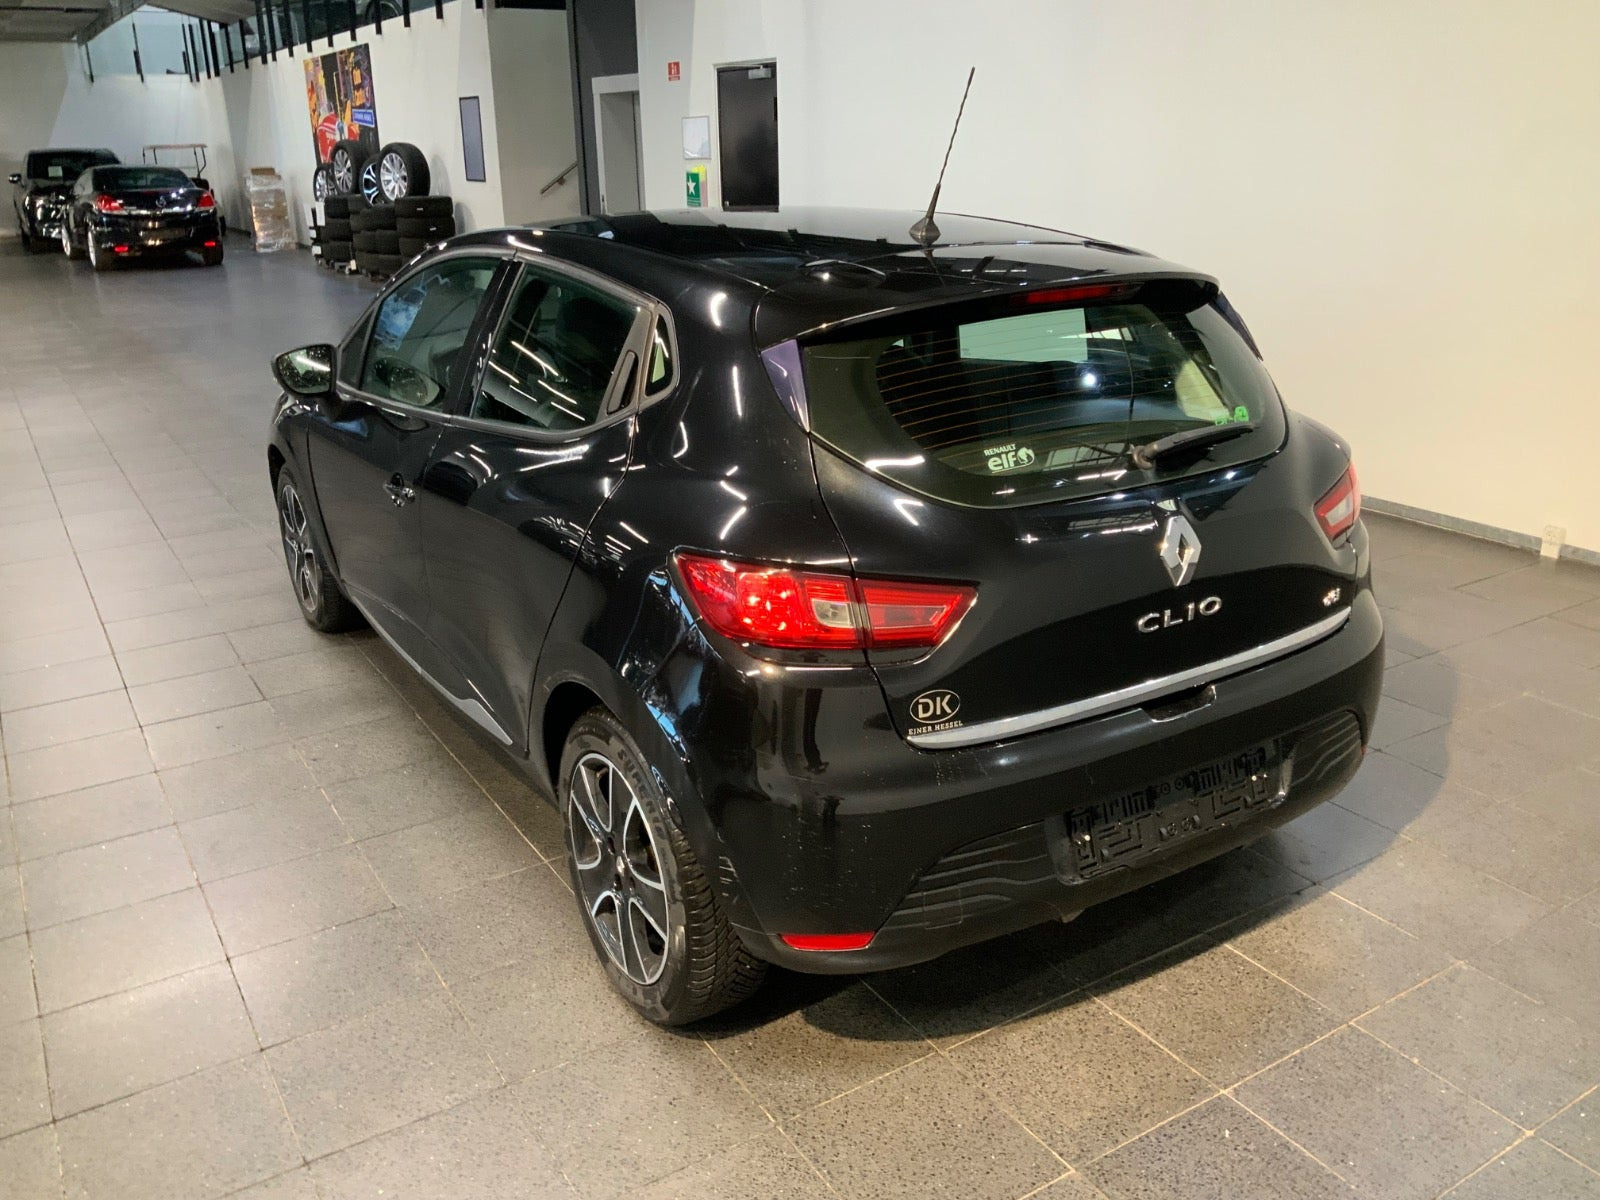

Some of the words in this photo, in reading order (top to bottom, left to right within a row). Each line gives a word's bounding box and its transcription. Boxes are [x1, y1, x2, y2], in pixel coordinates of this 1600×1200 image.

[984, 443, 1016, 457] RENAULT
[988, 451, 1017, 471] elf
[1136, 595, 1223, 634] CLIO
[917, 694, 952, 719] DK
[934, 720, 963, 731] HESSEL
